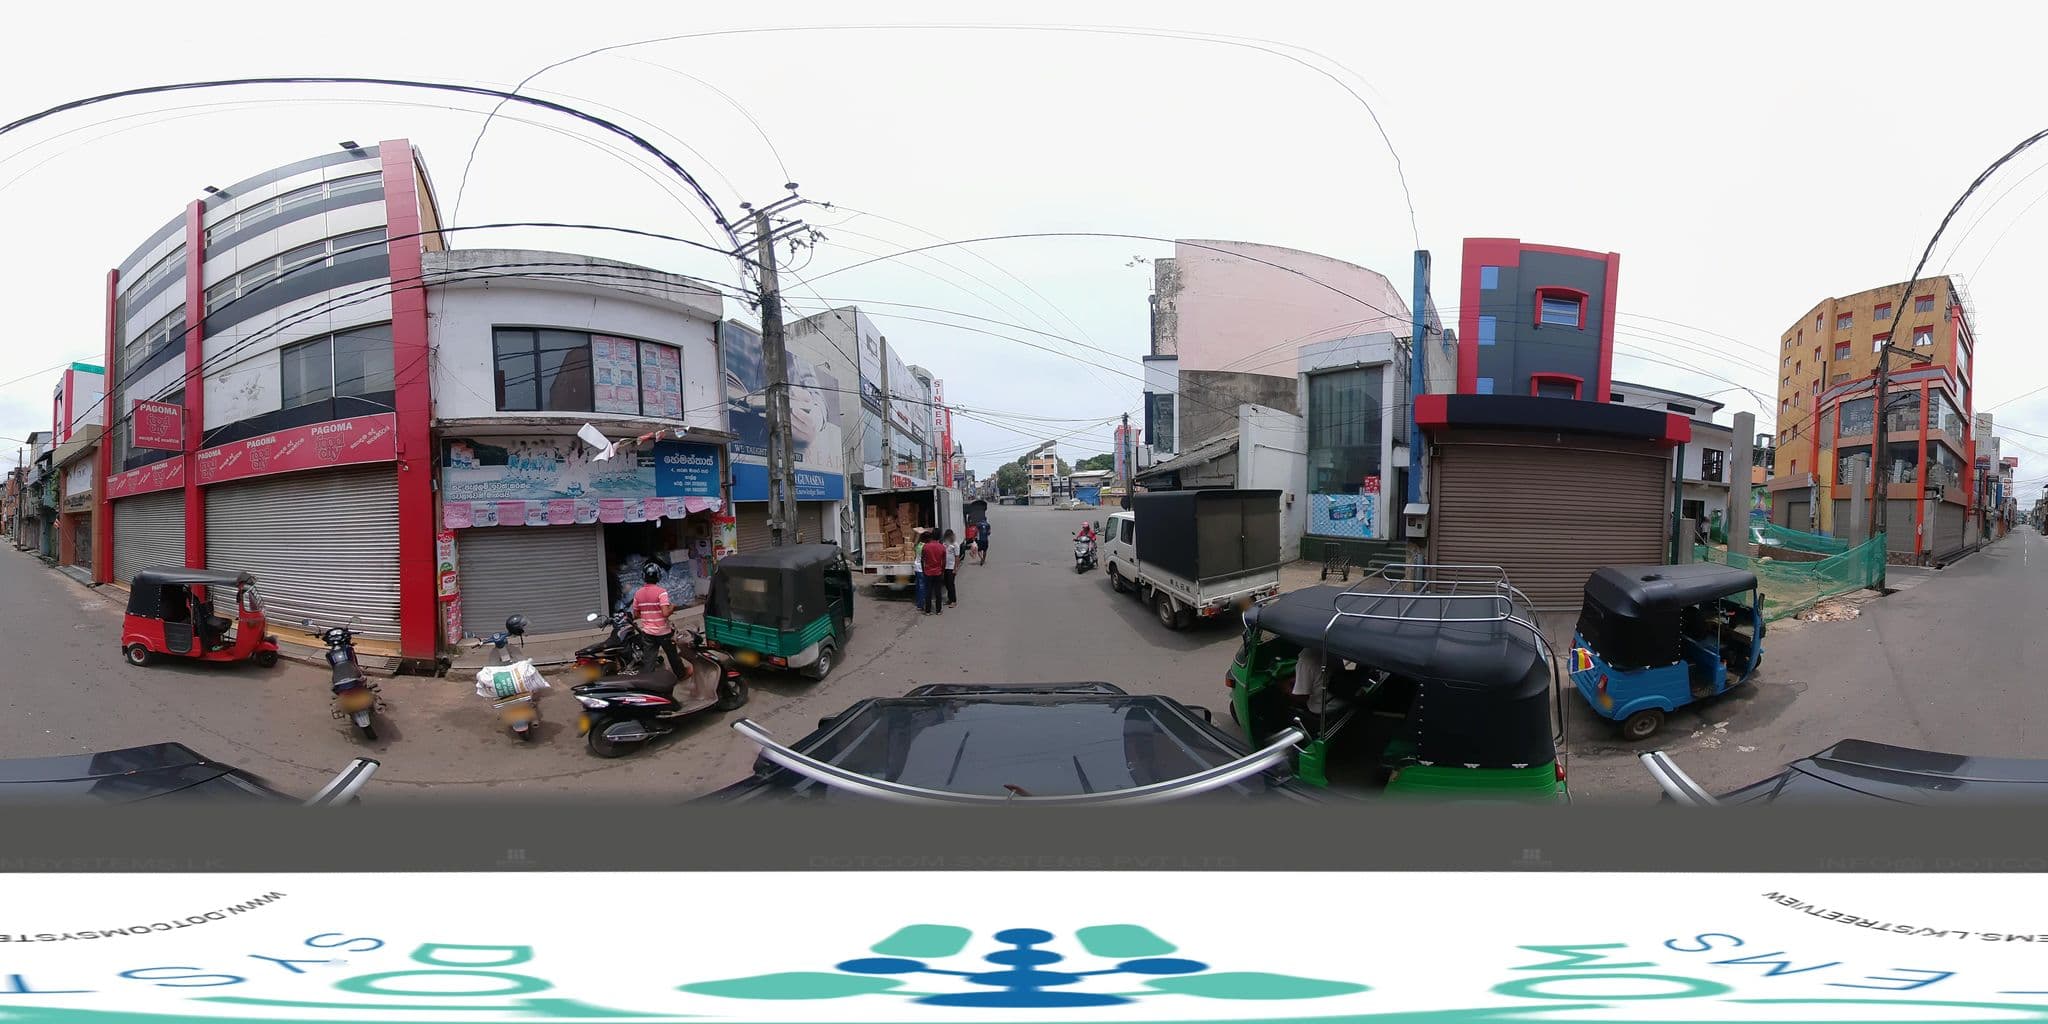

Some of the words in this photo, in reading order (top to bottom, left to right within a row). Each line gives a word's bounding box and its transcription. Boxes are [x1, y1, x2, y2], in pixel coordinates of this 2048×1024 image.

[140, 403, 177, 416] PAGOMA
[933, 380, 942, 426] SINGER
[311, 422, 353, 436] PAGOMA
[247, 435, 276, 448] PAGOMA
[197, 449, 222, 461] PAGOMA
[663, 452, 714, 466] හේමන්තාස්
